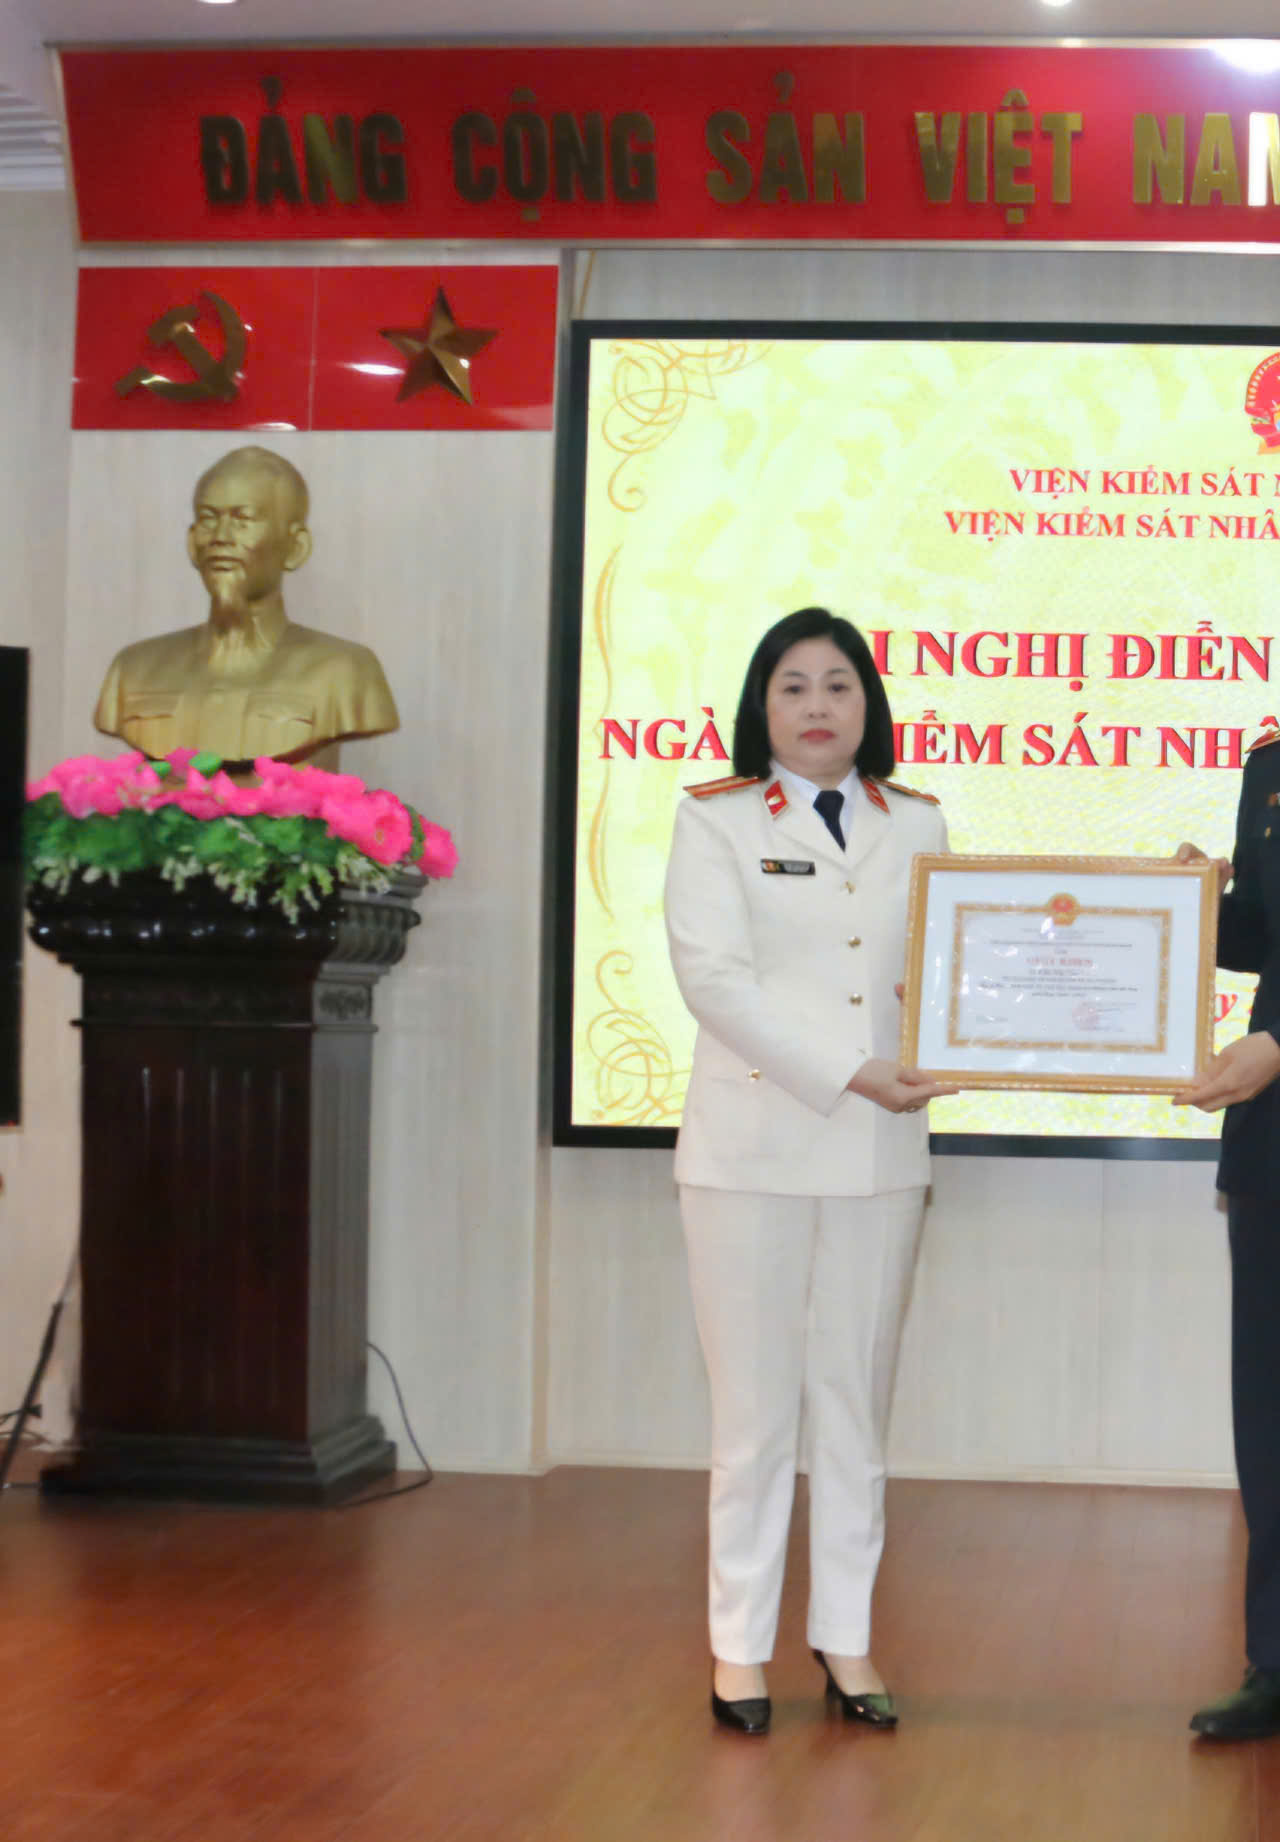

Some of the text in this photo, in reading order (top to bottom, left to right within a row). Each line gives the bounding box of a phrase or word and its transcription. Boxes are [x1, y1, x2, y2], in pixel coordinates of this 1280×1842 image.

[200, 75, 405, 210] ĐẢNG
[451, 87, 658, 222] CỘNG
[705, 71, 867, 205] SẢN
[914, 89, 1083, 224] VIỆT
[1009, 467, 1091, 500] VIỆN
[1201, 467, 1265, 497] SÁT
[944, 509, 1026, 542] VIỆN
[1136, 508, 1201, 539] SÁT
[911, 629, 1090, 692] NGHỊ
[598, 705, 733, 761] NGÀ
[1021, 712, 1142, 767] SÁT
